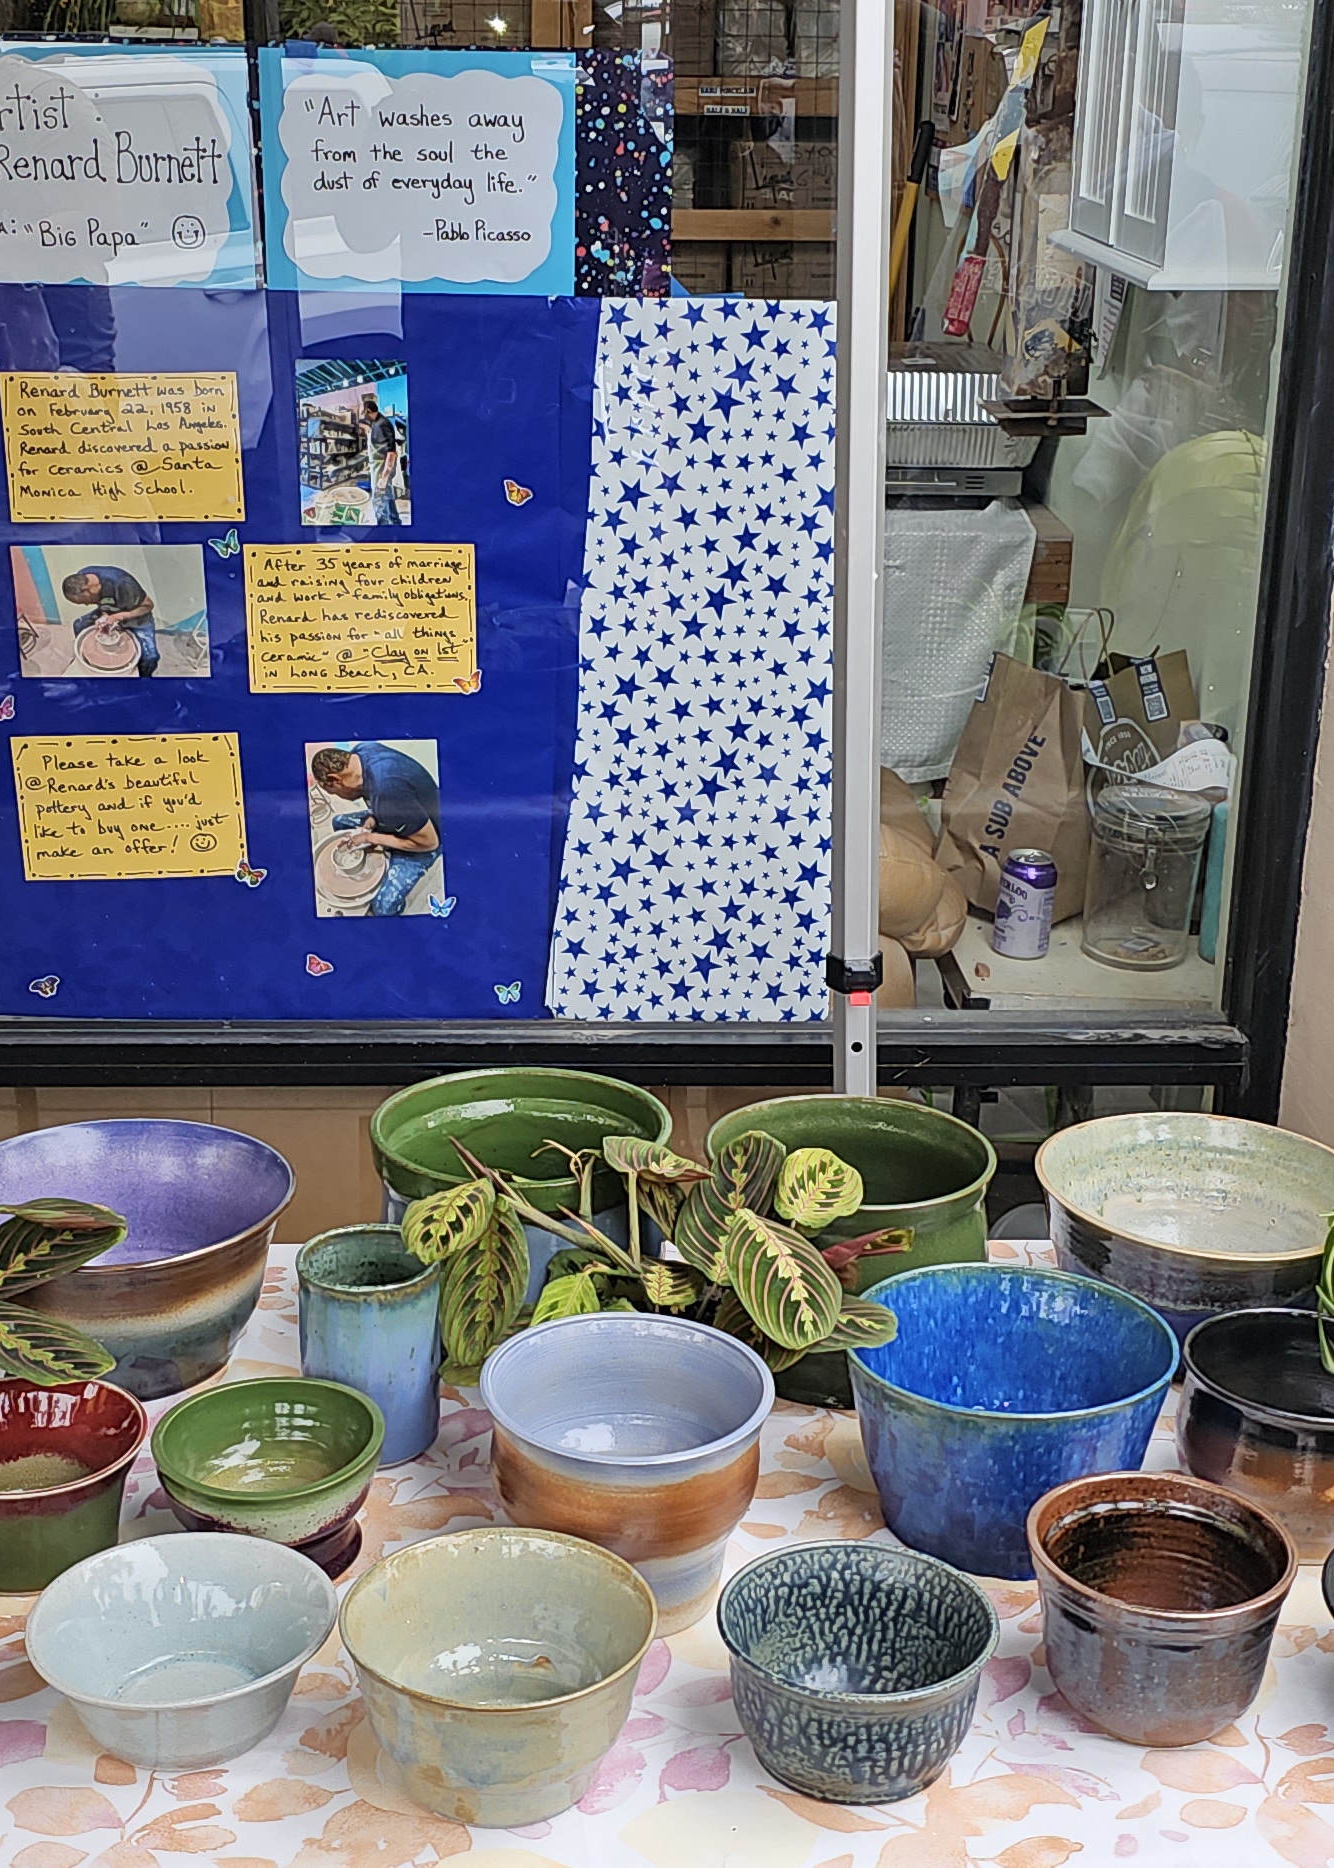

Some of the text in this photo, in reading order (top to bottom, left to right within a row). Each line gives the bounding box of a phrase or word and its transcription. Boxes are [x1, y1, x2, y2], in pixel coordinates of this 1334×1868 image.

[379, 104, 452, 128] washes
[468, 112, 525, 143] away
[115, 131, 222, 184] Burnett
[311, 139, 508, 163] from the soul the
[313, 172, 353, 191] dust
[362, 171, 380, 190] of
[391, 173, 475, 205] everyday
[475, 219, 531, 242] Picasso
[20, 380, 224, 399] Renard Burnett was born
[17, 407, 36, 416] on
[50, 403, 115, 424] February
[161, 402, 191, 414] 1958
[18, 424, 62, 436] South
[70, 420, 133, 434] Central
[146, 419, 170, 430] Los
[20, 441, 71, 456] Renard
[78, 437, 158, 454] discovered
[163, 442, 175, 451] a
[18, 457, 223, 476] for ceramics @ Santa
[92, 480, 126, 501] High
[134, 479, 193, 495] School.
[264, 556, 467, 575] After 35 years of marriage
[257, 576, 287, 587] and
[291, 576, 350, 594] raising
[355, 574, 384, 586] four
[293, 591, 332, 601] work
[352, 589, 404, 607] family
[260, 606, 459, 624] Renard has rediscovered
[260, 630, 281, 643] his
[347, 628, 369, 640] for
[412, 627, 456, 645] things
[336, 649, 365, 663] @
[42, 749, 210, 771] Please take a look
[124, 771, 199, 789] beautiful
[985, 800, 1013, 839] SUB
[1002, 735, 1046, 798] ABOVE
[35, 793, 202, 820] pottery and if you'd
[34, 824, 63, 838] like
[66, 822, 85, 835] to
[98, 819, 125, 841] buy
[195, 813, 229, 830] just
[37, 846, 84, 860] make
[92, 846, 114, 855] an
